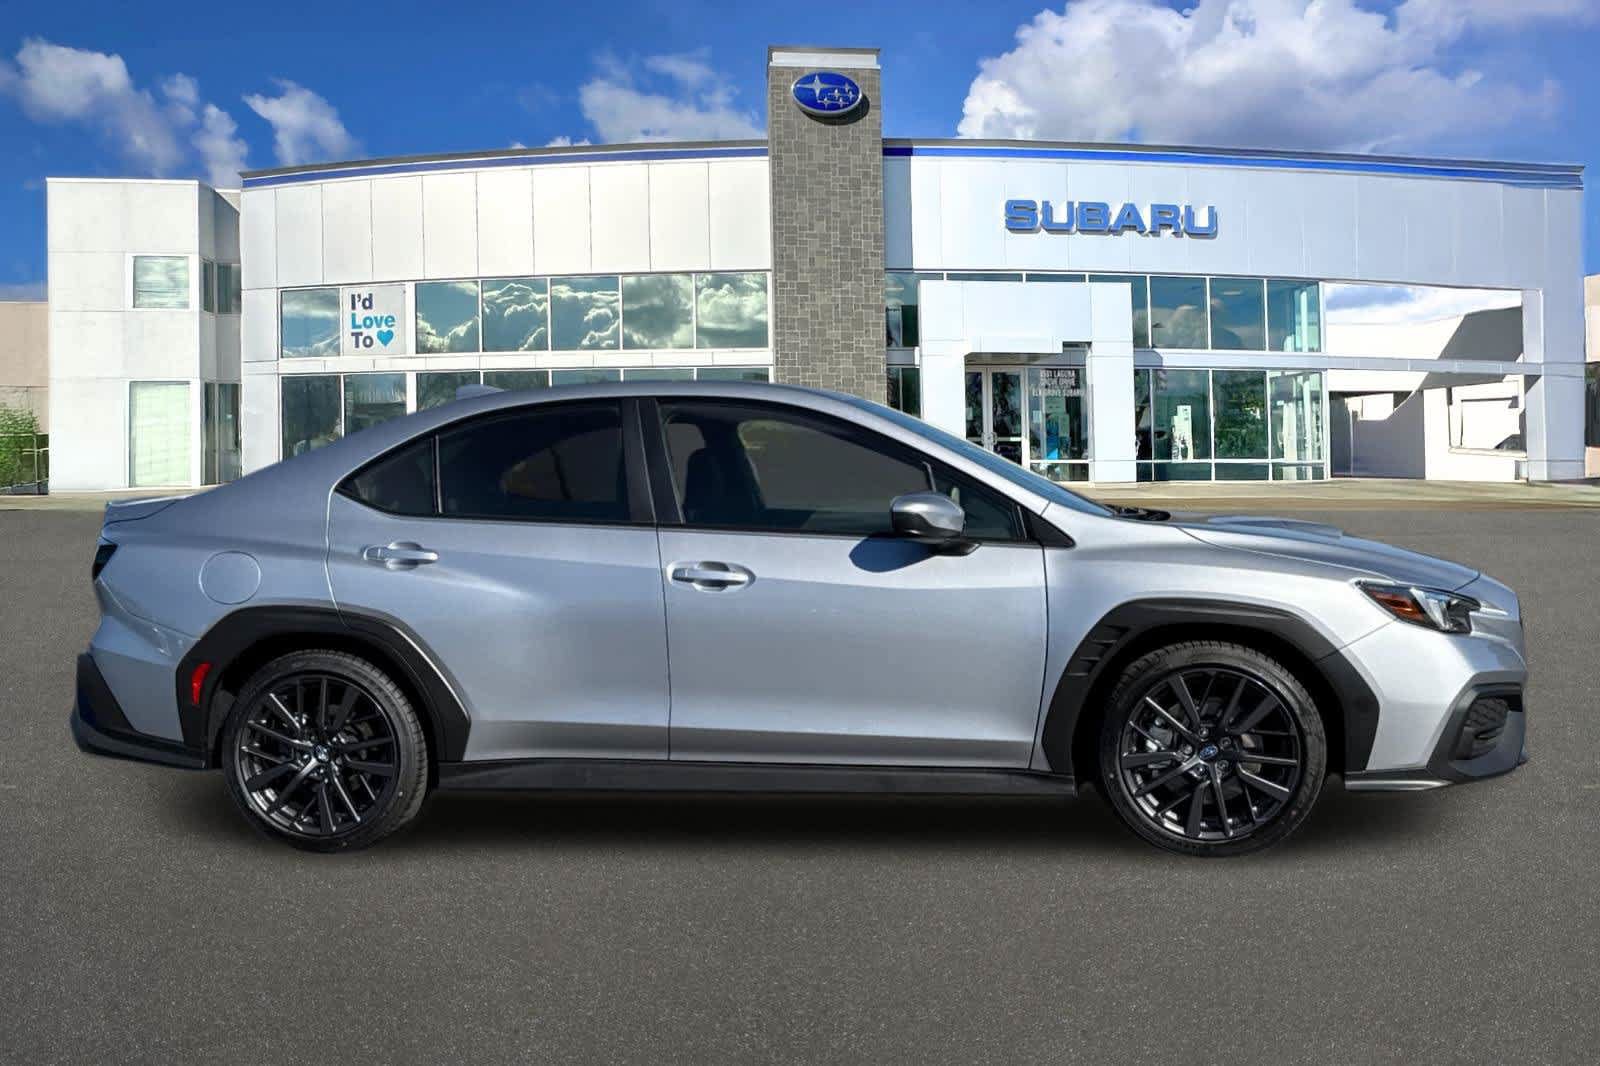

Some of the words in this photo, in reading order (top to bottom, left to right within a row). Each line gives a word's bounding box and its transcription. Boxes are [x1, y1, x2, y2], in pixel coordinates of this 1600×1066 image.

[1005, 199, 1218, 239] SUBARU
[351, 293, 373, 310] I'd
[351, 312, 396, 330] Love
[351, 331, 374, 348] To
